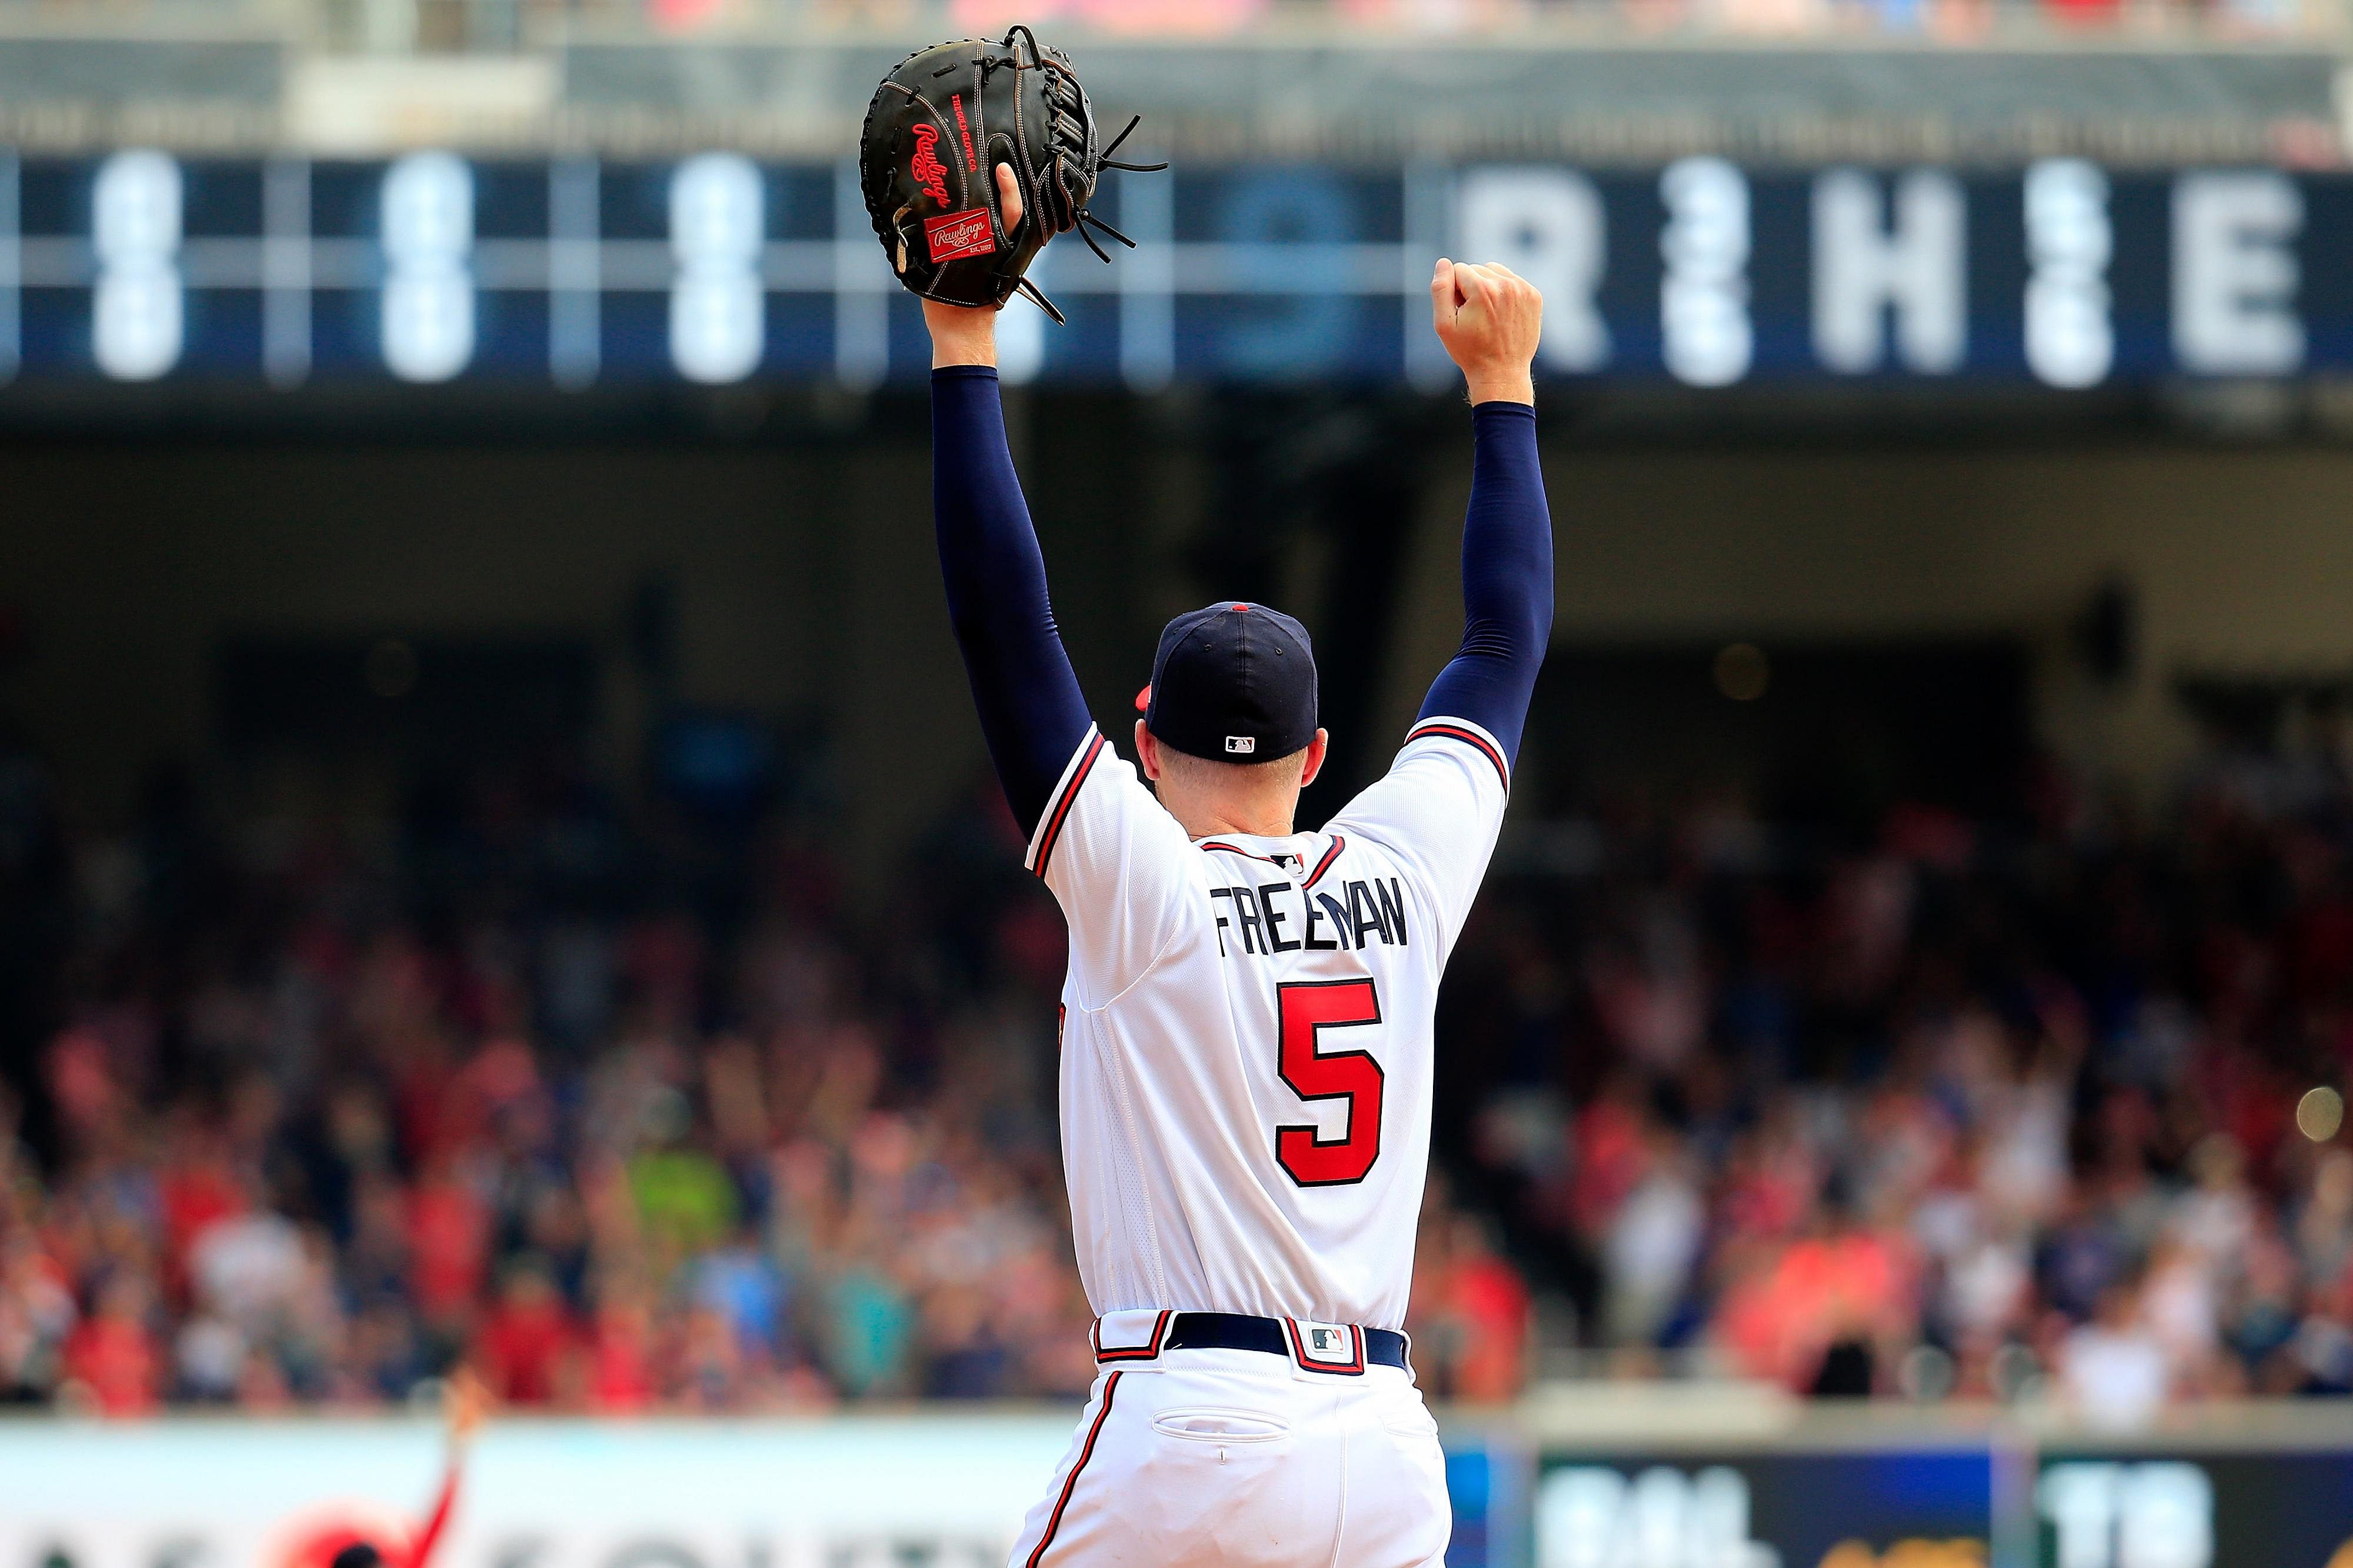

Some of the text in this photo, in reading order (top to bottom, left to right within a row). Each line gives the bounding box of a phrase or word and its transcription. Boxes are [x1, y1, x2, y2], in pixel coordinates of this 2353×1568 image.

[956, 111, 968, 132] GOLD
[961, 132, 976, 158] GLOVE
[912, 124, 951, 209] Rawlings
[934, 222, 985, 247] Rawlings
[1460, 165, 1612, 374] R
[1809, 165, 1968, 376] H
[2169, 168, 2307, 376] E
[1209, 878, 1407, 957] FREEMAN
[1276, 977, 1384, 1187] 5
